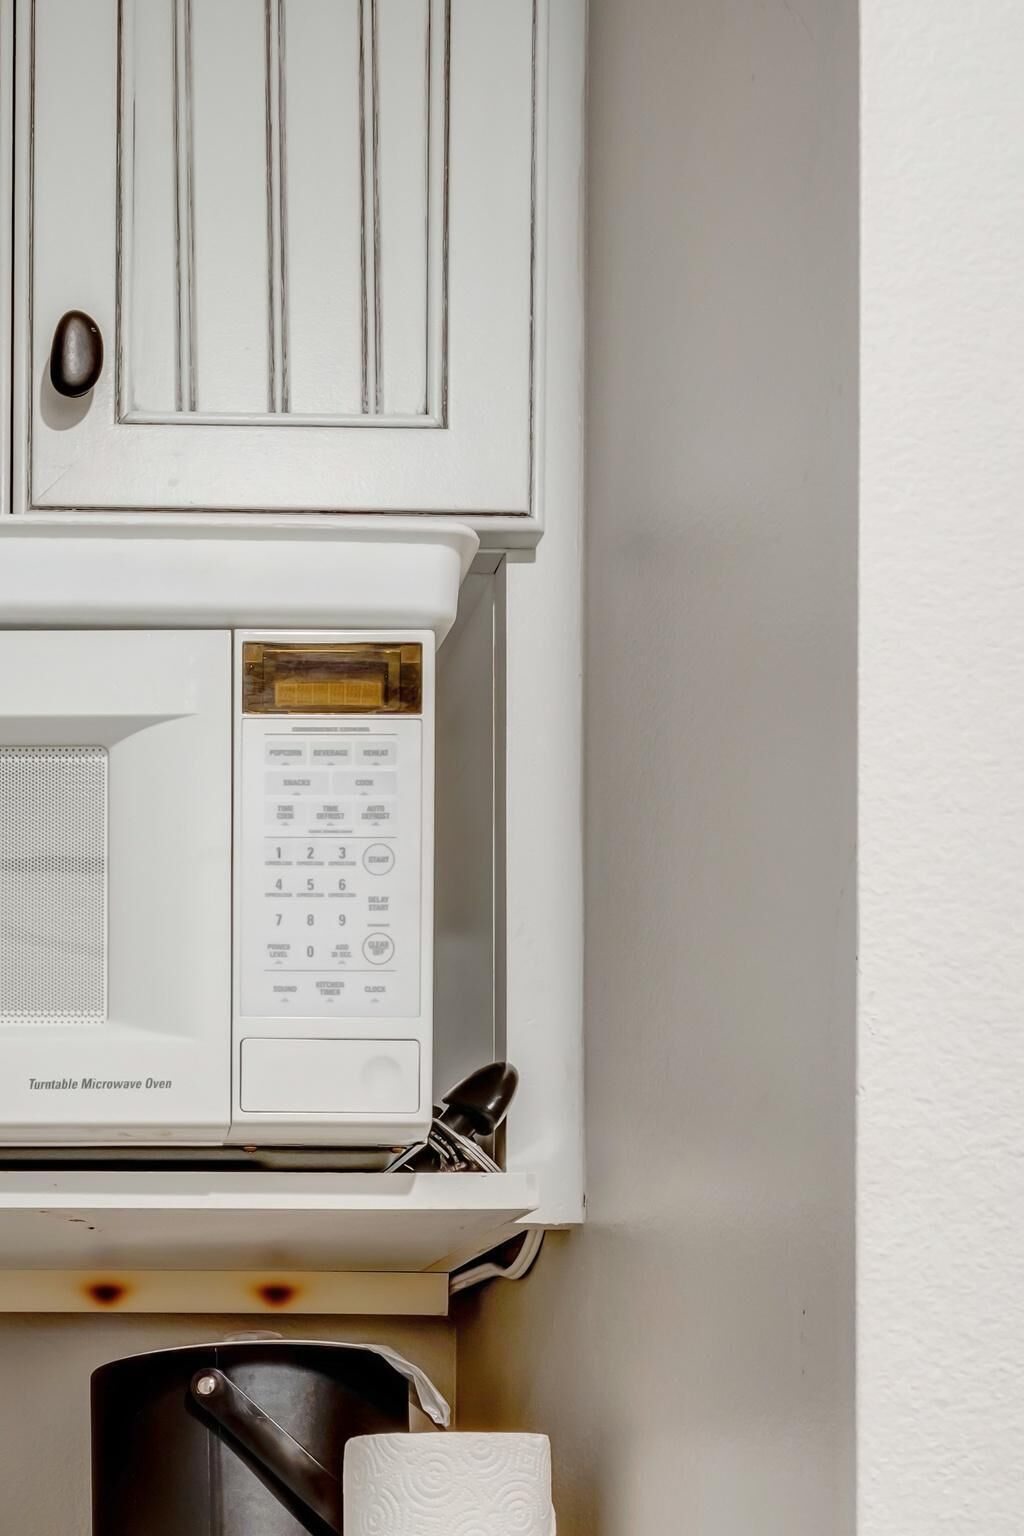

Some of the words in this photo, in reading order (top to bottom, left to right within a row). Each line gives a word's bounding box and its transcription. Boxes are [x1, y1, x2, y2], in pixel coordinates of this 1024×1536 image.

[276, 847, 282, 859] 1
[307, 847, 315, 859] 2
[338, 847, 346, 859] 3
[275, 878, 283, 890] 4
[307, 879, 315, 891] 5
[338, 879, 346, 891] 6
[275, 914, 283, 926] 7
[307, 914, 315, 926] 8
[338, 914, 346, 926] 9
[306, 945, 314, 958] 0
[28, 1078, 78, 1090] Turntable
[81, 1077, 143, 1090] Microwave
[145, 1077, 173, 1089] Oven
